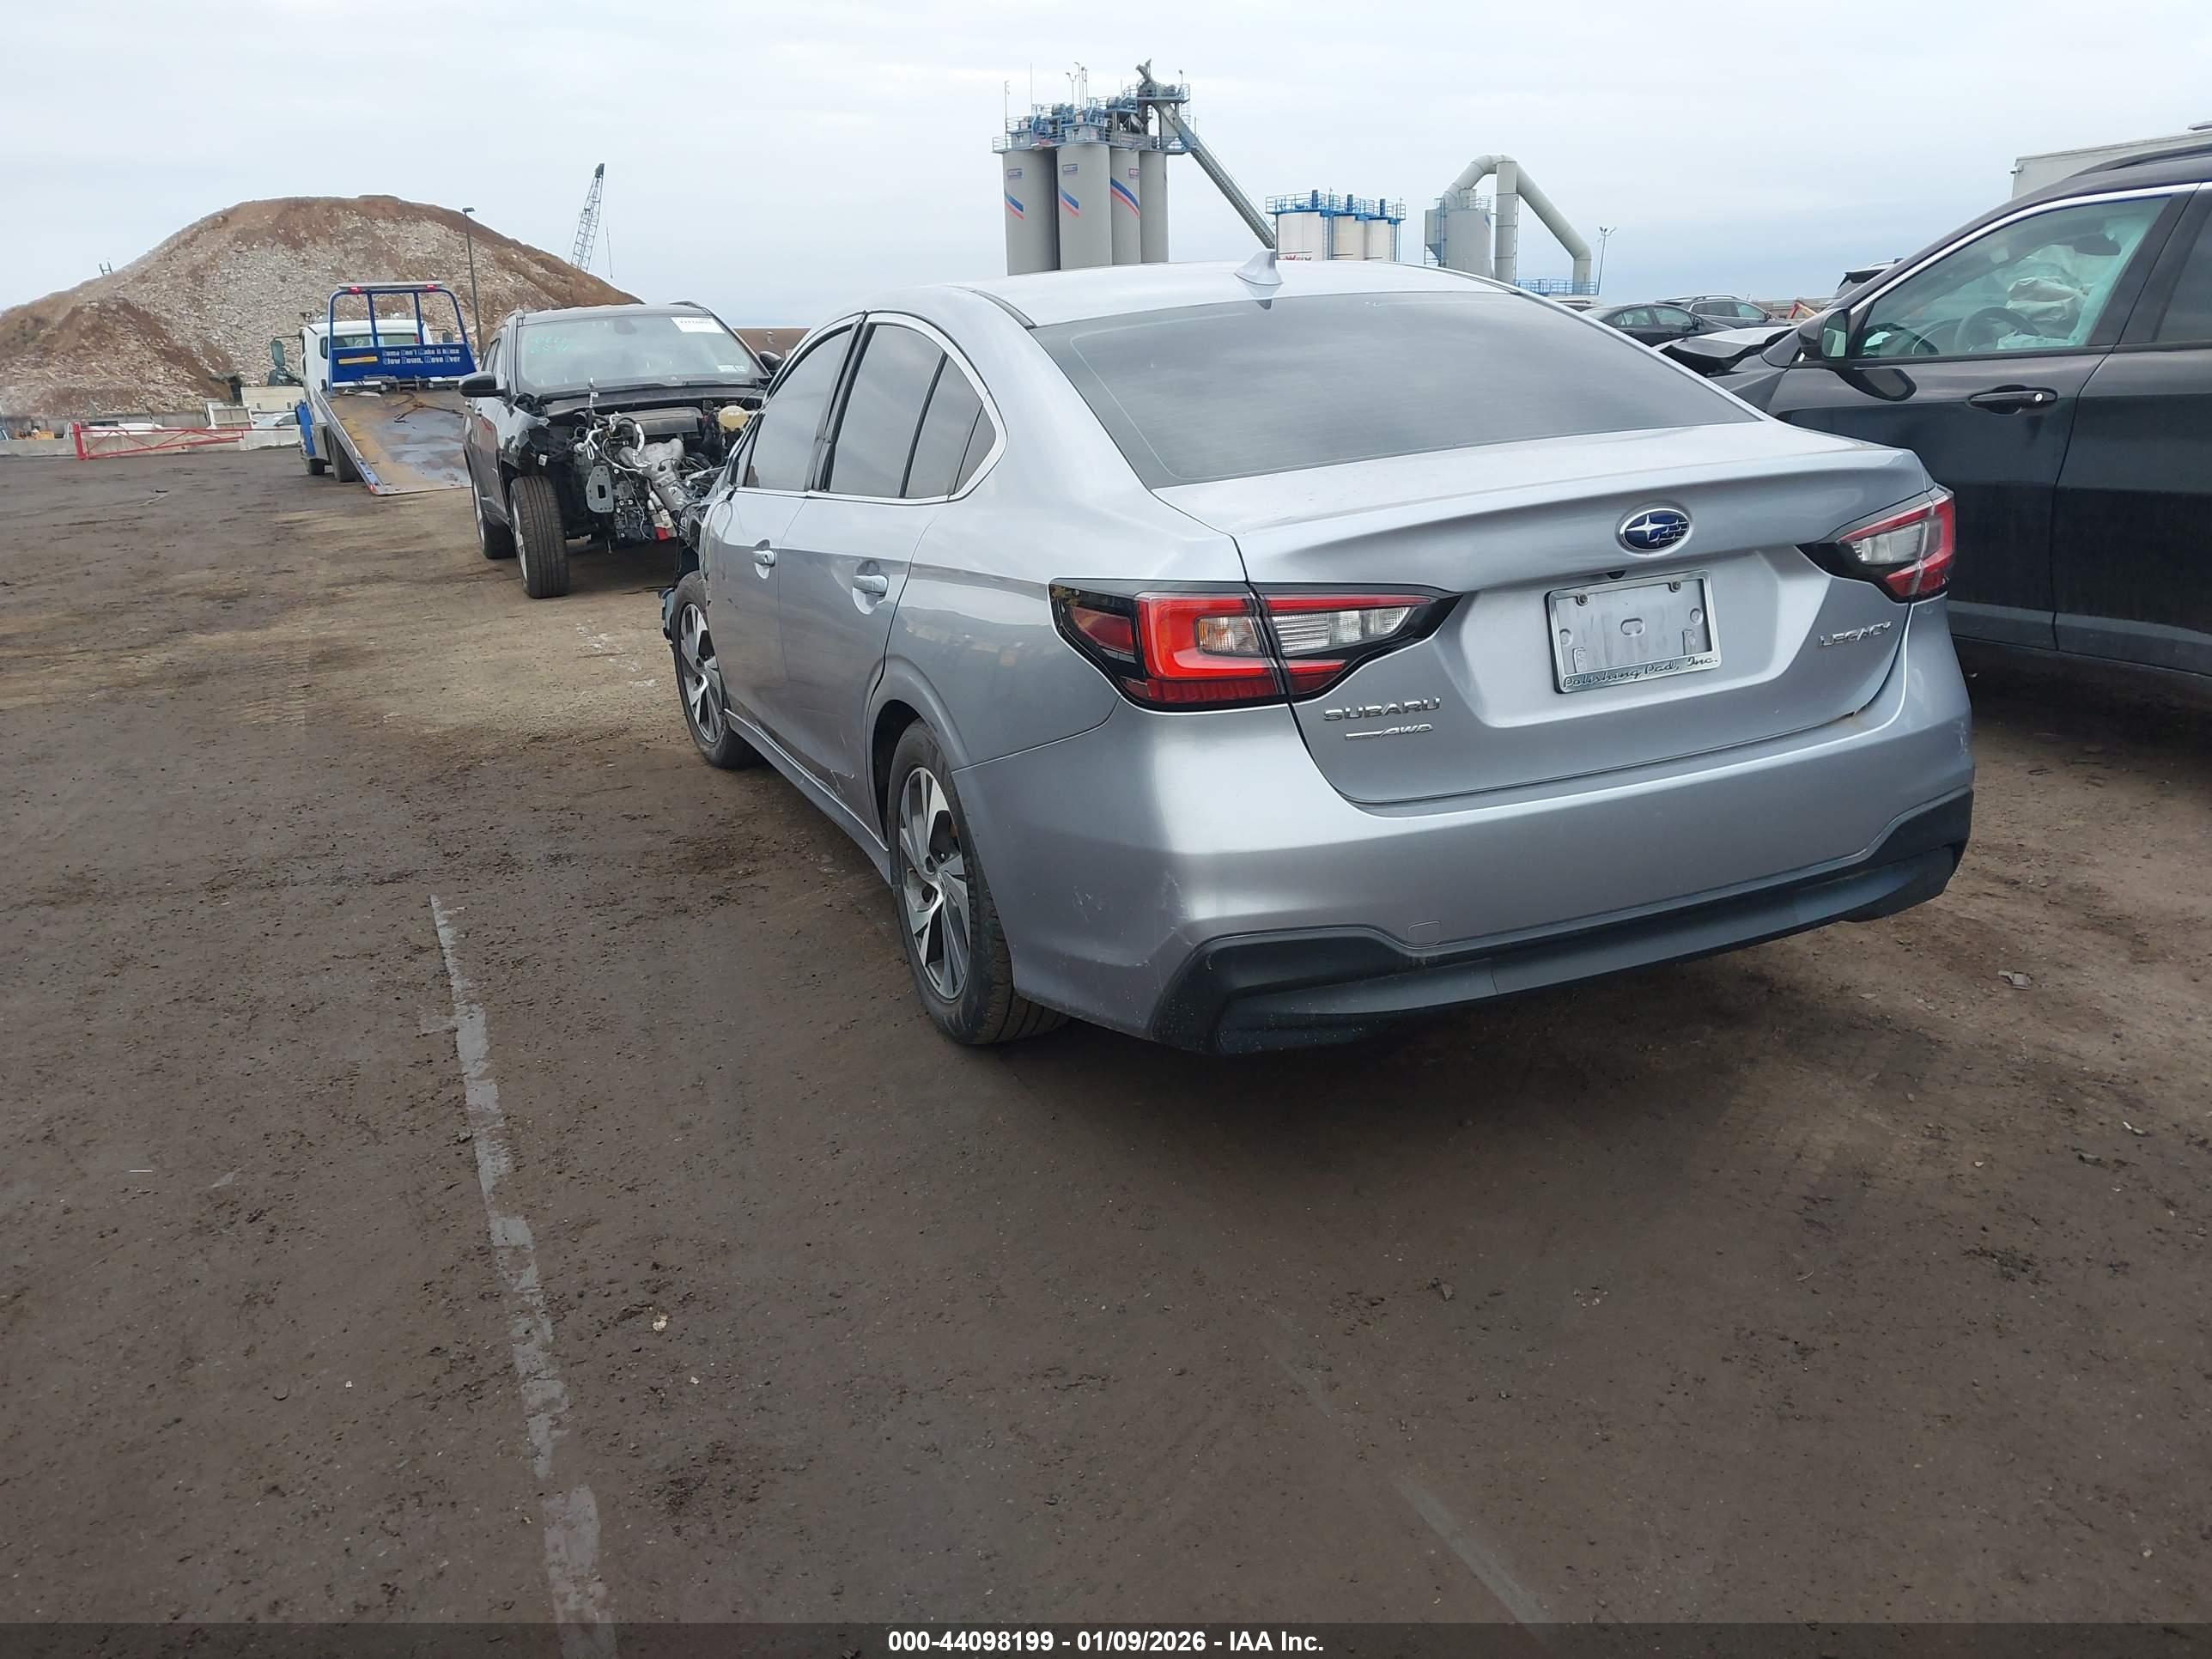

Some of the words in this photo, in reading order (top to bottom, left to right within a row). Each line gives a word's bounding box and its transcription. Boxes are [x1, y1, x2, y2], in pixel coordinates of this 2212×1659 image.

[1819, 621, 1892, 647] LEGACY
[1564, 669, 1641, 690] Polishing
[1644, 660, 1680, 675] Pad,
[1686, 656, 1717, 666] Inc.
[1323, 697, 1440, 721] SUBARU
[1379, 723, 1433, 738] AWD
